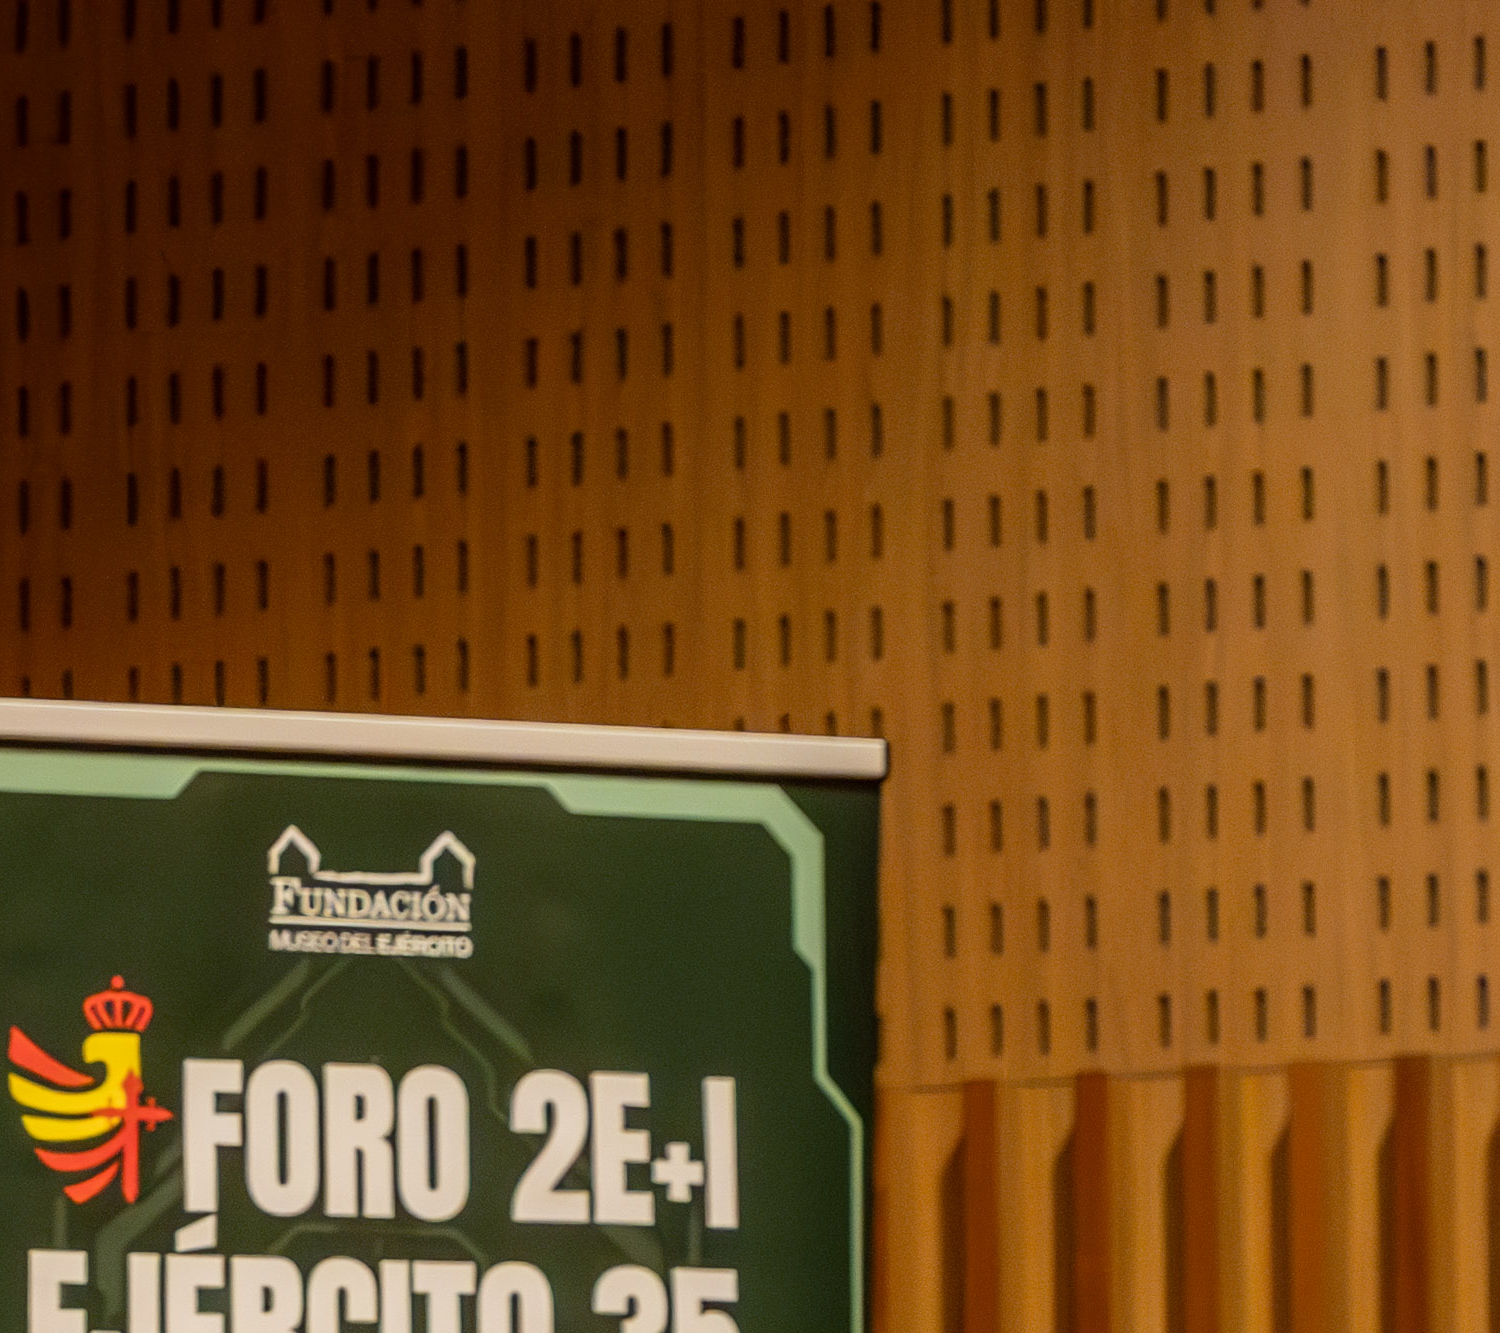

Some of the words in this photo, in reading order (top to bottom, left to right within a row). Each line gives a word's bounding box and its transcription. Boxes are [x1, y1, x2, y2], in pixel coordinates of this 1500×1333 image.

[269, 876, 472, 923] FUNDACIÓN
[268, 929, 338, 952] MUSEO
[182, 1058, 471, 1223] FORO
